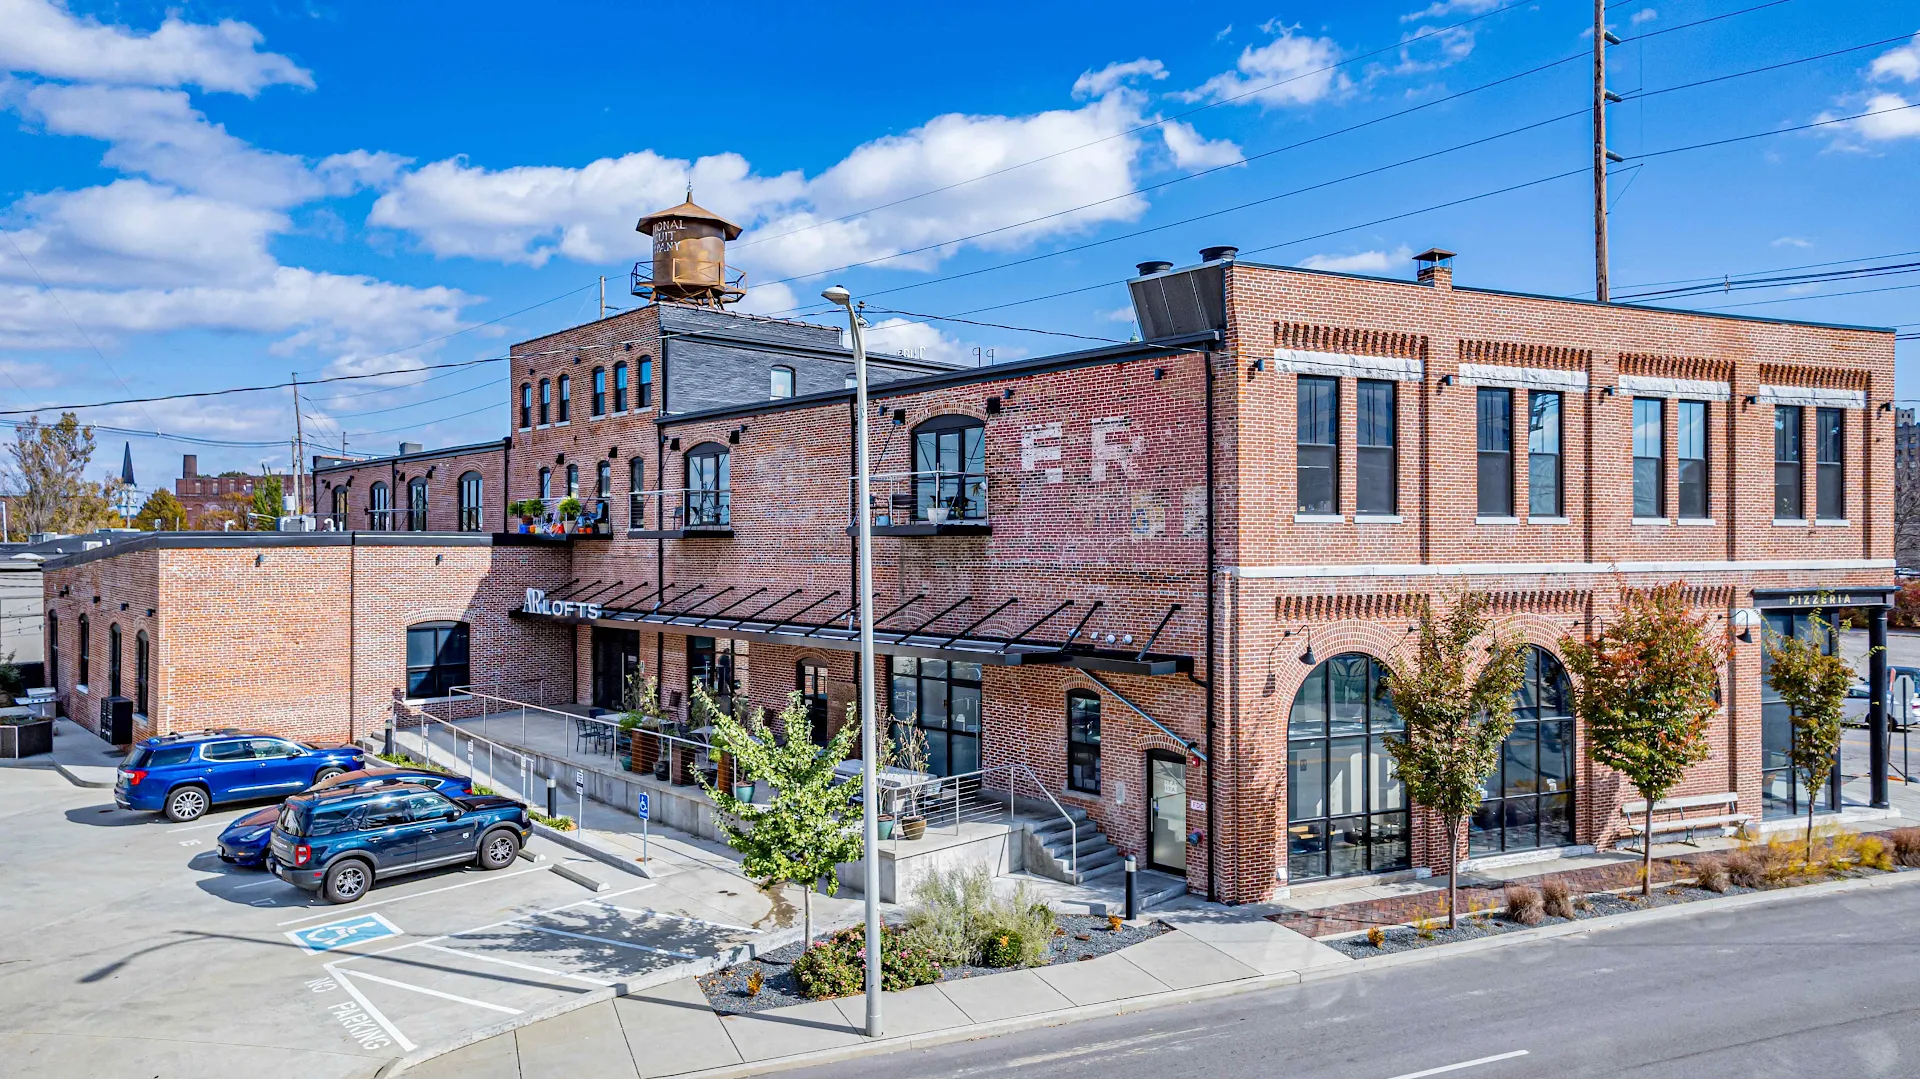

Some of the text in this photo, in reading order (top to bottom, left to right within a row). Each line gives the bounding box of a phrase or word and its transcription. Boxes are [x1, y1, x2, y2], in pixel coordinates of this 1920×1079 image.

[543, 599, 602, 620] LOFTS
[1789, 594, 1851, 605] PIZZERIA
[304, 976, 391, 1050] NO PARKING
